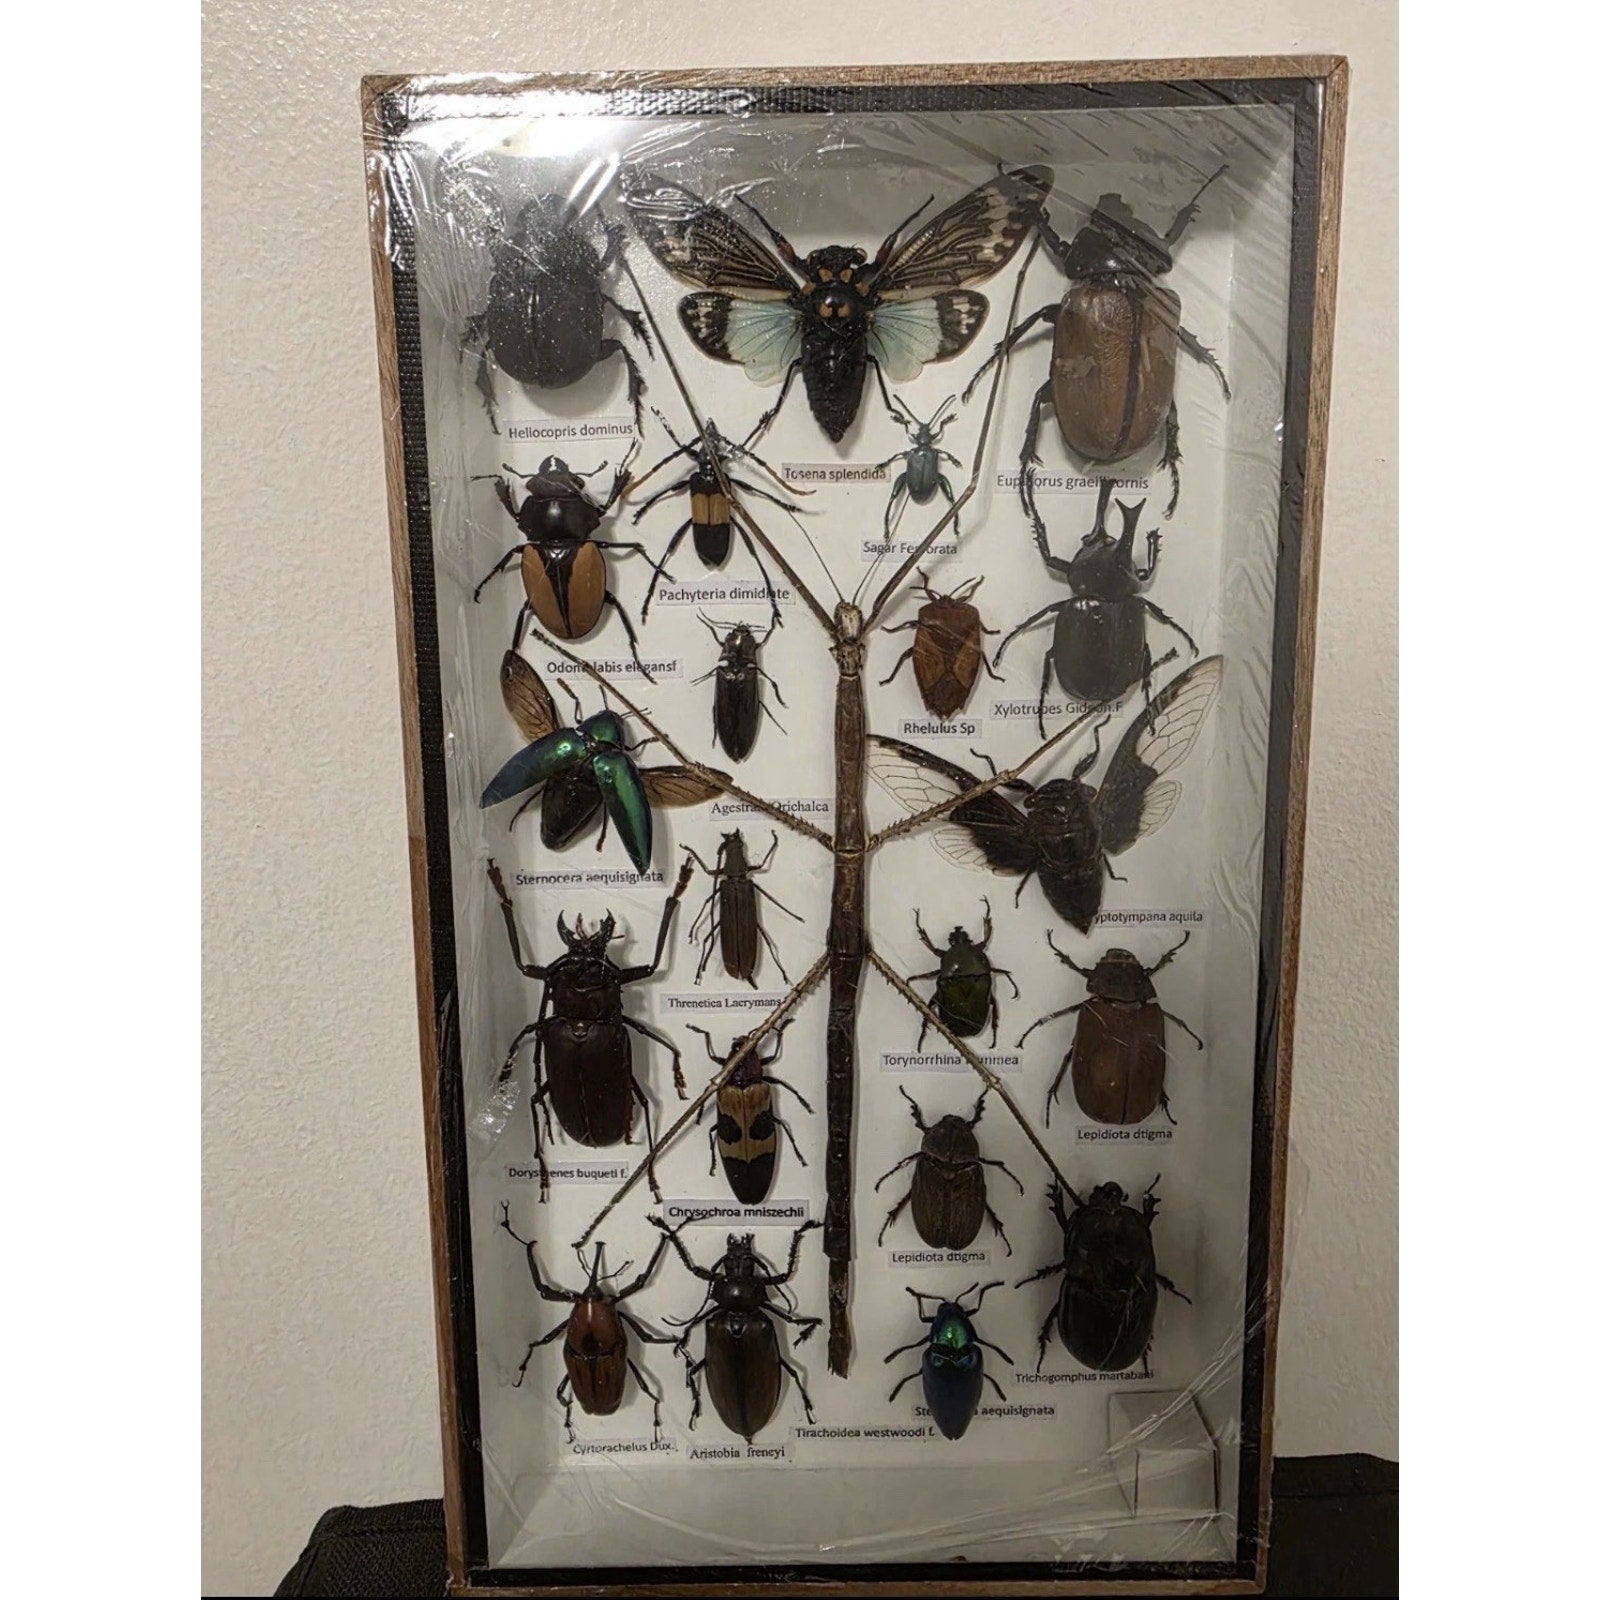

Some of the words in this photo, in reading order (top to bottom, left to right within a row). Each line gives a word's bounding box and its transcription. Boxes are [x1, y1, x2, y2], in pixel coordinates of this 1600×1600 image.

[508, 426, 578, 440] Heliocopris
[579, 423, 634, 437] dominus
[784, 467, 827, 480] Tosena
[828, 467, 887, 482] splendida
[996, 474, 1063, 489] Euporus
[862, 541, 897, 556] Sagar
[899, 542, 958, 555] Feorata
[658, 587, 727, 603] Pachyteria
[546, 660, 623, 674] Odontlabis
[903, 722, 958, 735] Rhelulus
[959, 722, 976, 736] Sp
[515, 873, 583, 886] Sternocera
[1168, 910, 1203, 923] aquila
[667, 997, 723, 1009] Threnetica
[724, 997, 782, 1010] Lacrymans
[883, 1053, 962, 1067] Torynorrhina
[1077, 1129, 1131, 1141] Lepidiota
[508, 1167, 575, 1180] Dorysenes
[576, 1167, 618, 1181] buqueti
[668, 1206, 741, 1219] Chrysochroa
[743, 1206, 805, 1218] mniszechii
[892, 1252, 944, 1264] Lepidiota
[1015, 1372, 1098, 1385] Trichogomphus
[981, 1405, 1055, 1417] aequisignata
[794, 1428, 861, 1438] Tirachoidea
[863, 1428, 926, 1438] westwoodi
[689, 1447, 741, 1460] Aristobia
[746, 1445, 786, 1460] freneyi
